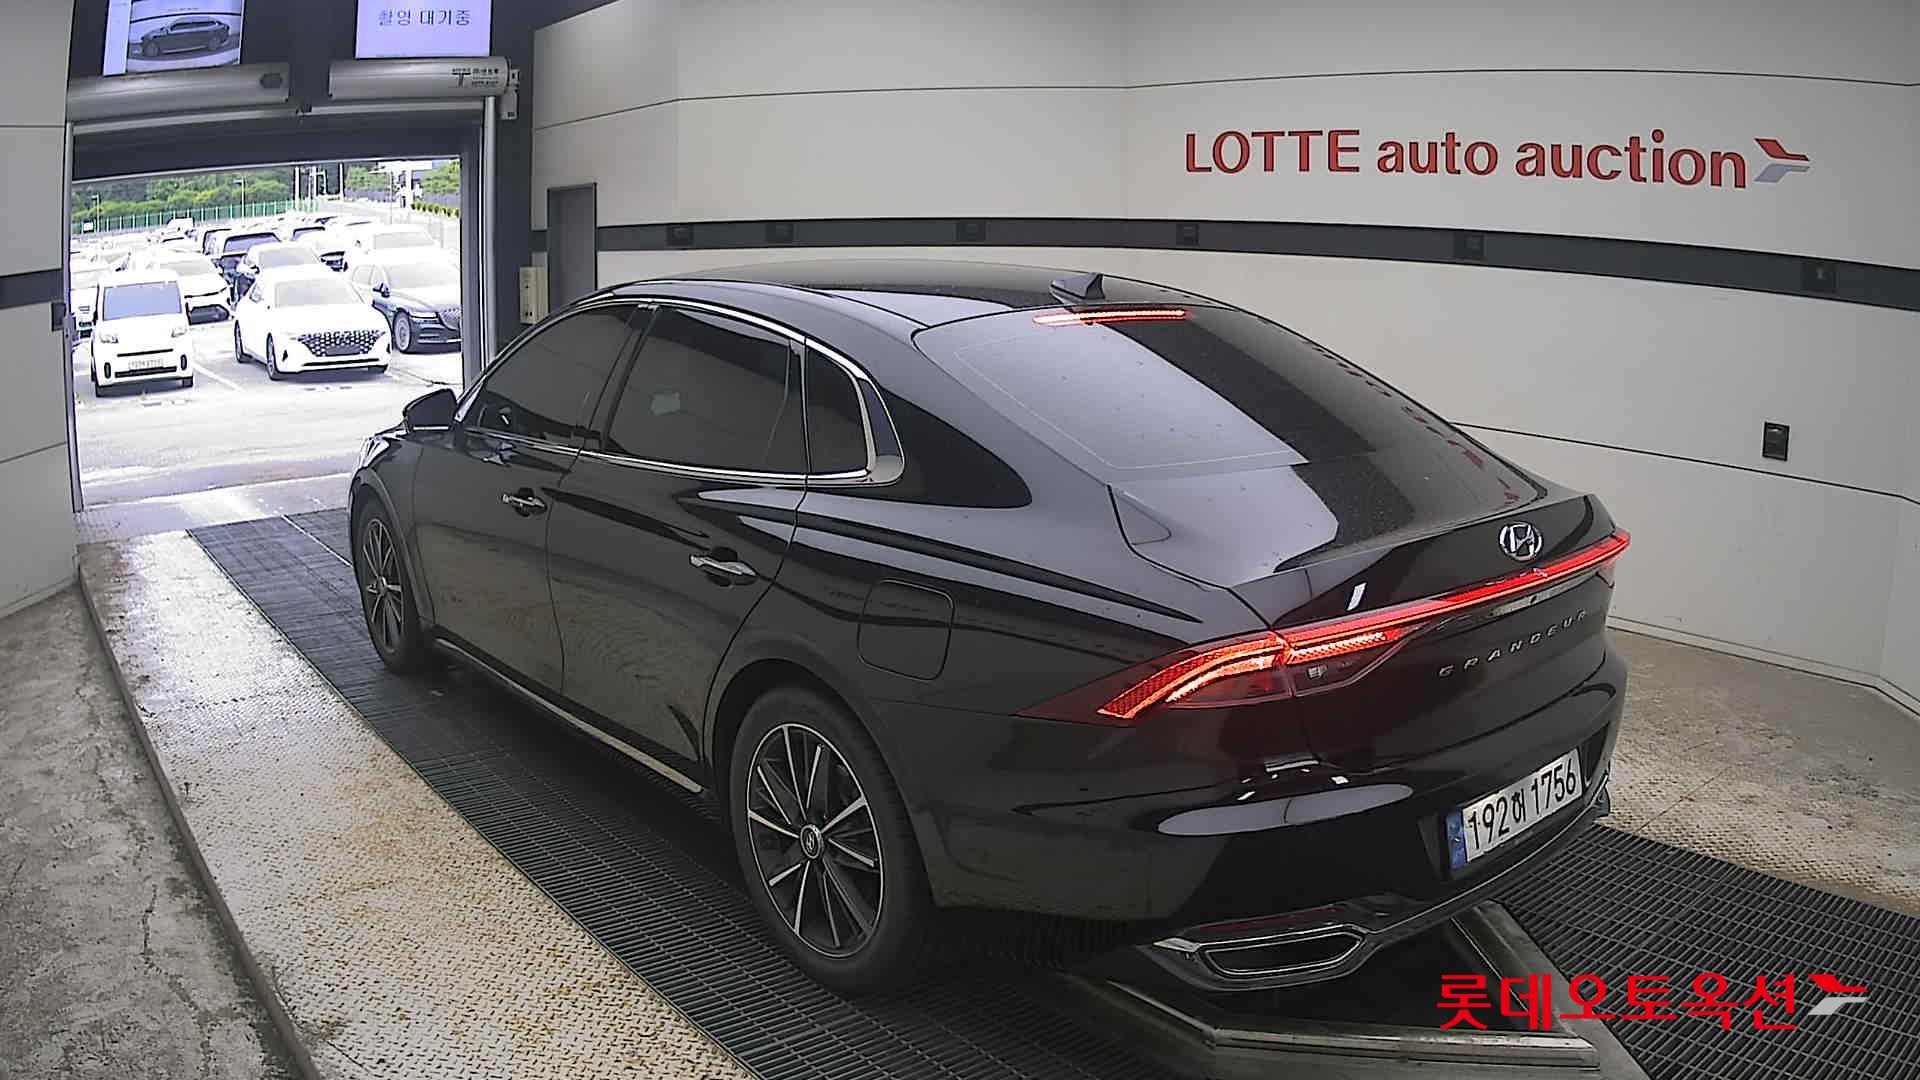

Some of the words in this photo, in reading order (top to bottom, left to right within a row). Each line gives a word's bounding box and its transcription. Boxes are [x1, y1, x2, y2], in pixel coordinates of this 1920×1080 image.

[420, 9, 470, 26] 대기중
[1185, 129, 1361, 175] LOTTE
[1377, 131, 1499, 176] auto
[1514, 128, 1747, 189] auction
[1438, 607, 1588, 677] GRANDEUR
[1531, 758, 1577, 815] 1756
